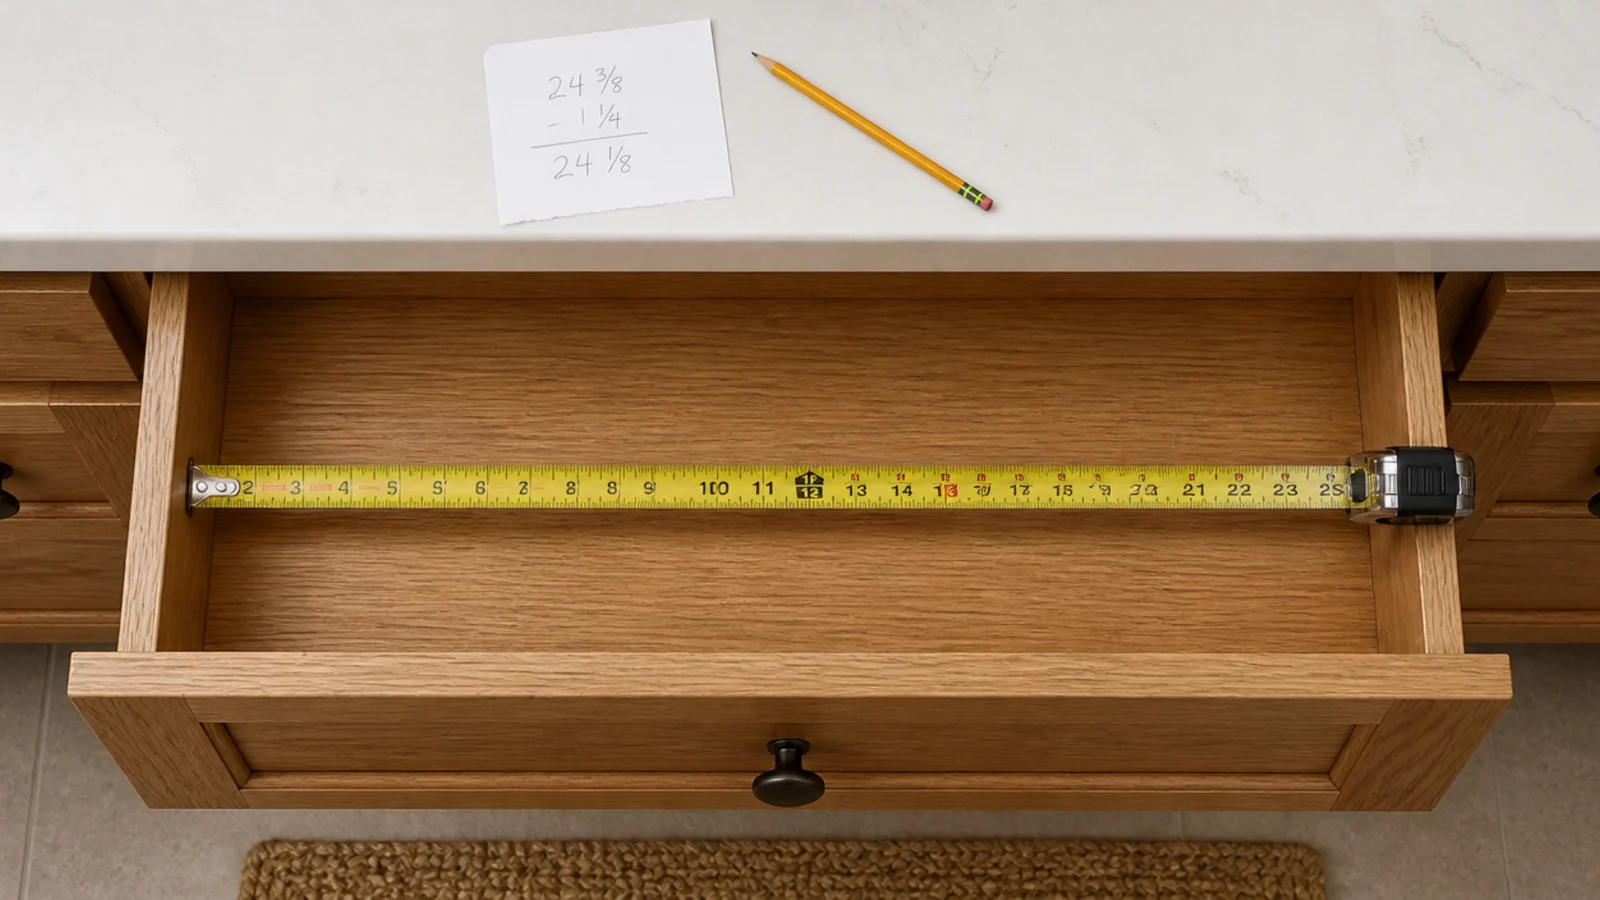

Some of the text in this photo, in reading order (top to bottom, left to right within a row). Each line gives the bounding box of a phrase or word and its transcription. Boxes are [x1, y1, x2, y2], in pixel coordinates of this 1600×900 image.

[548, 65, 623, 100] 24 3/8
[580, 108, 586, 128] 1
[598, 103, 622, 130] 1/4
[553, 145, 632, 180] 24 1/8
[242, 480, 254, 495] 2
[290, 480, 301, 495] 3
[338, 480, 349, 495] 4
[475, 480, 486, 495] 6
[606, 480, 618, 495] 8
[752, 481, 774, 495] 11
[801, 487, 819, 498] 12
[846, 484, 868, 497] 13
[891, 484, 913, 497] 14
[1182, 484, 1205, 496] 21
[1227, 483, 1252, 496] 22
[1273, 483, 1298, 496] 23
